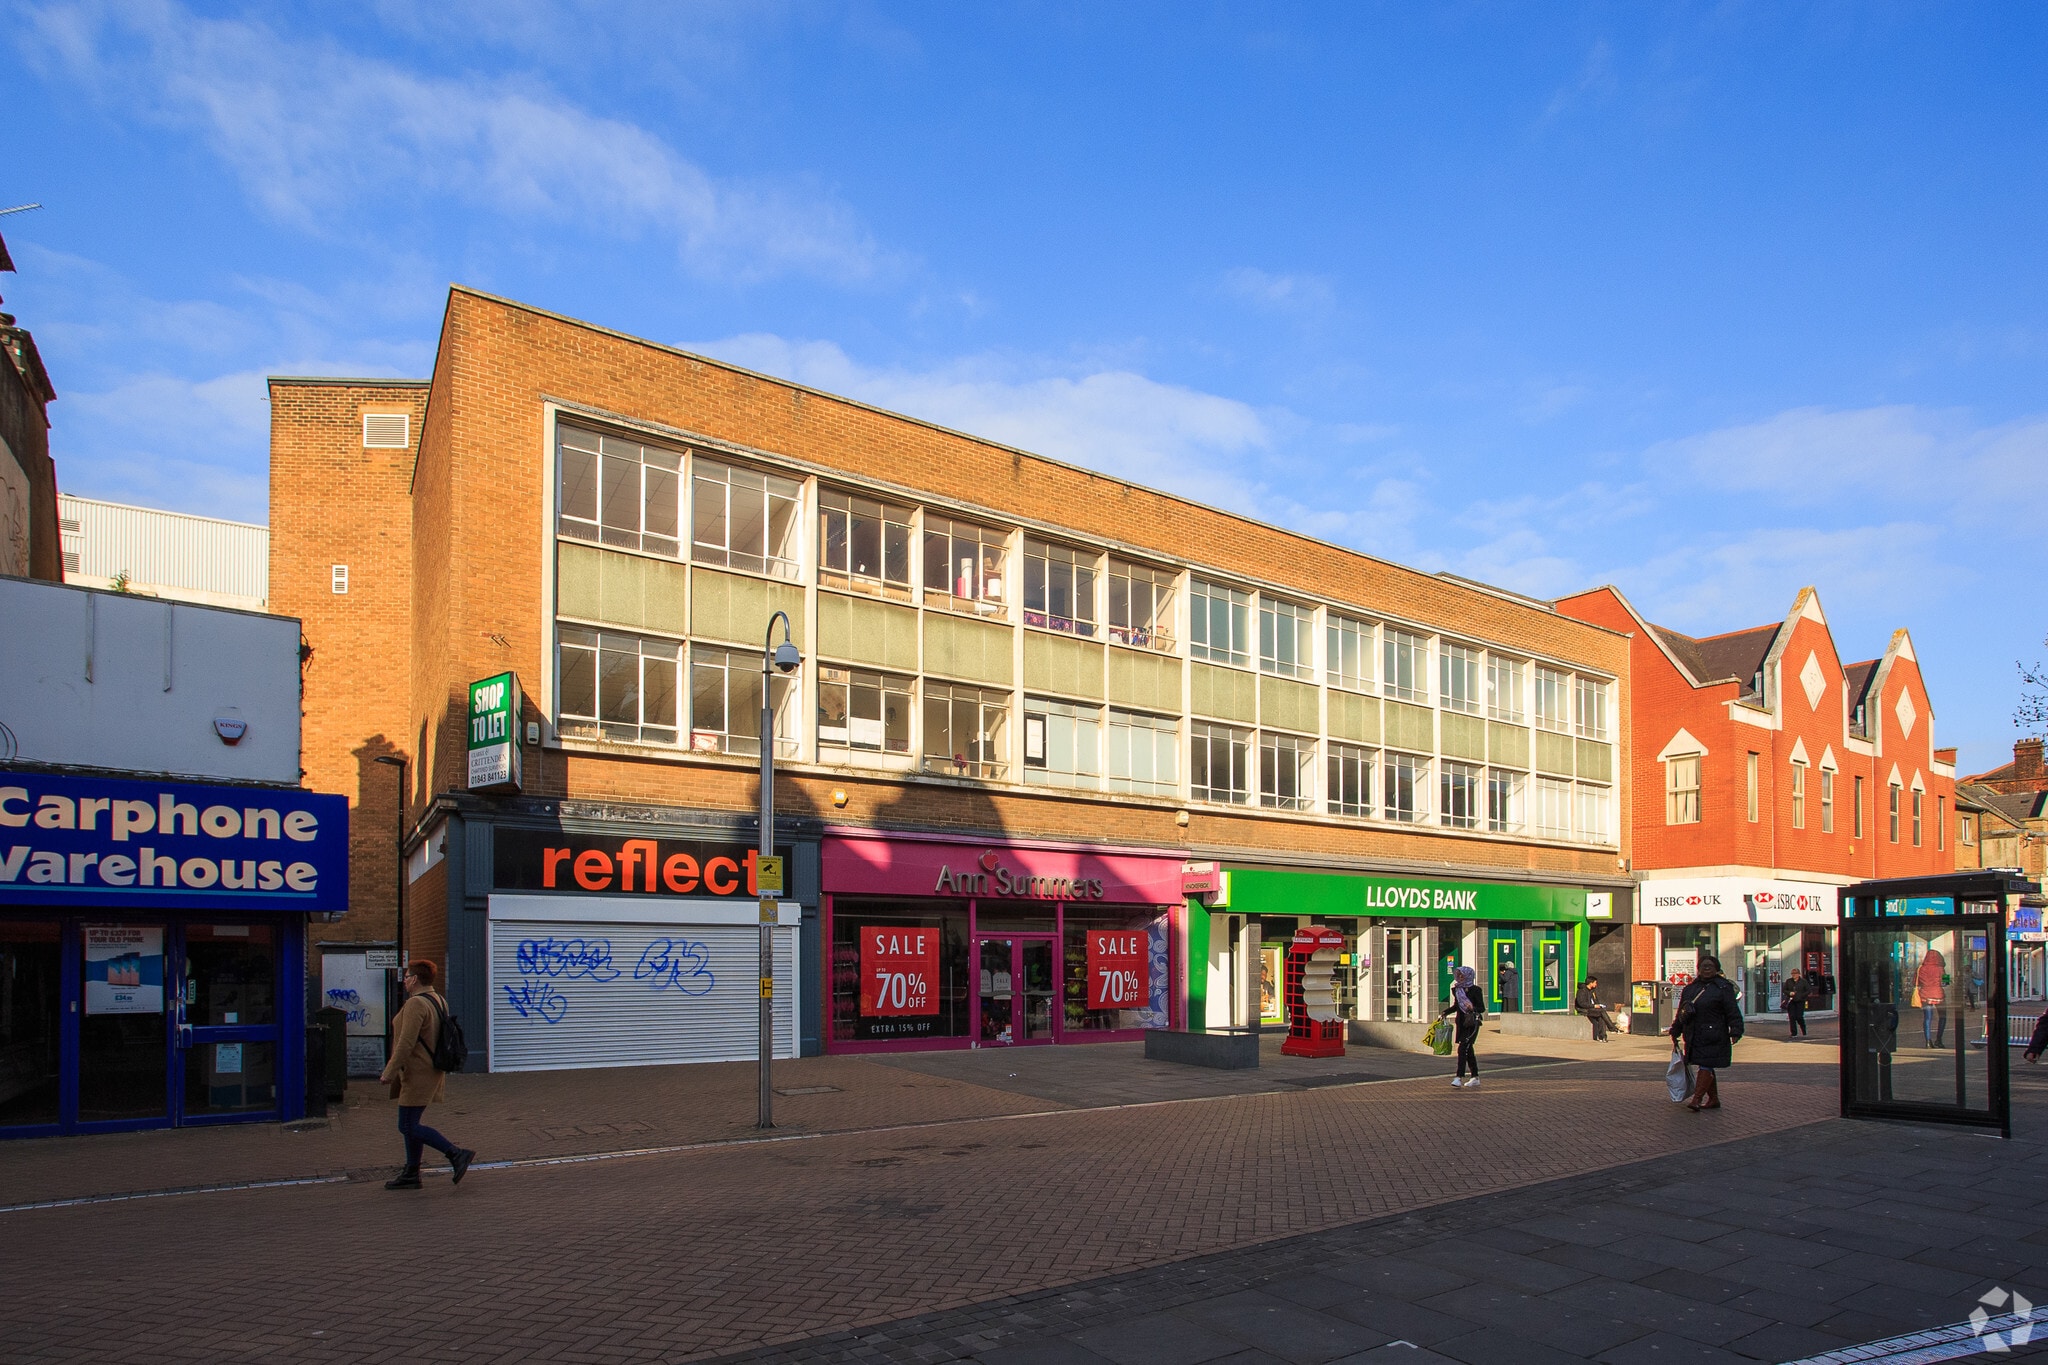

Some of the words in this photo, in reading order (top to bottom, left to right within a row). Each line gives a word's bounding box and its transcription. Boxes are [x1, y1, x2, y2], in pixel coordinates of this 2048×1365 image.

[475, 682, 504, 714] SHOP
[472, 716, 486, 743] TO
[487, 710, 507, 740] LET
[471, 754, 507, 768] CRITTENDEN
[471, 773, 487, 785] 01843
[487, 770, 507, 782] 841123
[0, 786, 319, 842] Carphone
[543, 839, 759, 896] reflect
[935, 864, 988, 894] Ann
[995, 867, 1104, 898] Summers
[1366, 885, 1430, 909] LLOYDS
[1433, 889, 1477, 911] BANK
[1655, 896, 1685, 907] HSBC
[1703, 895, 1722, 906] UK
[1808, 895, 1822, 912] UK
[876, 934, 925, 955] SALE
[1098, 937, 1137, 955] SALE
[876, 972, 926, 1009] 70%
[1099, 970, 1138, 1003] 70%
[1124, 991, 1138, 1002] OFF
[908, 997, 926, 1008] OFF
[871, 1024, 895, 1034] EXTRA
[898, 1023, 914, 1032] 15%
[917, 1022, 931, 1031] OFF
